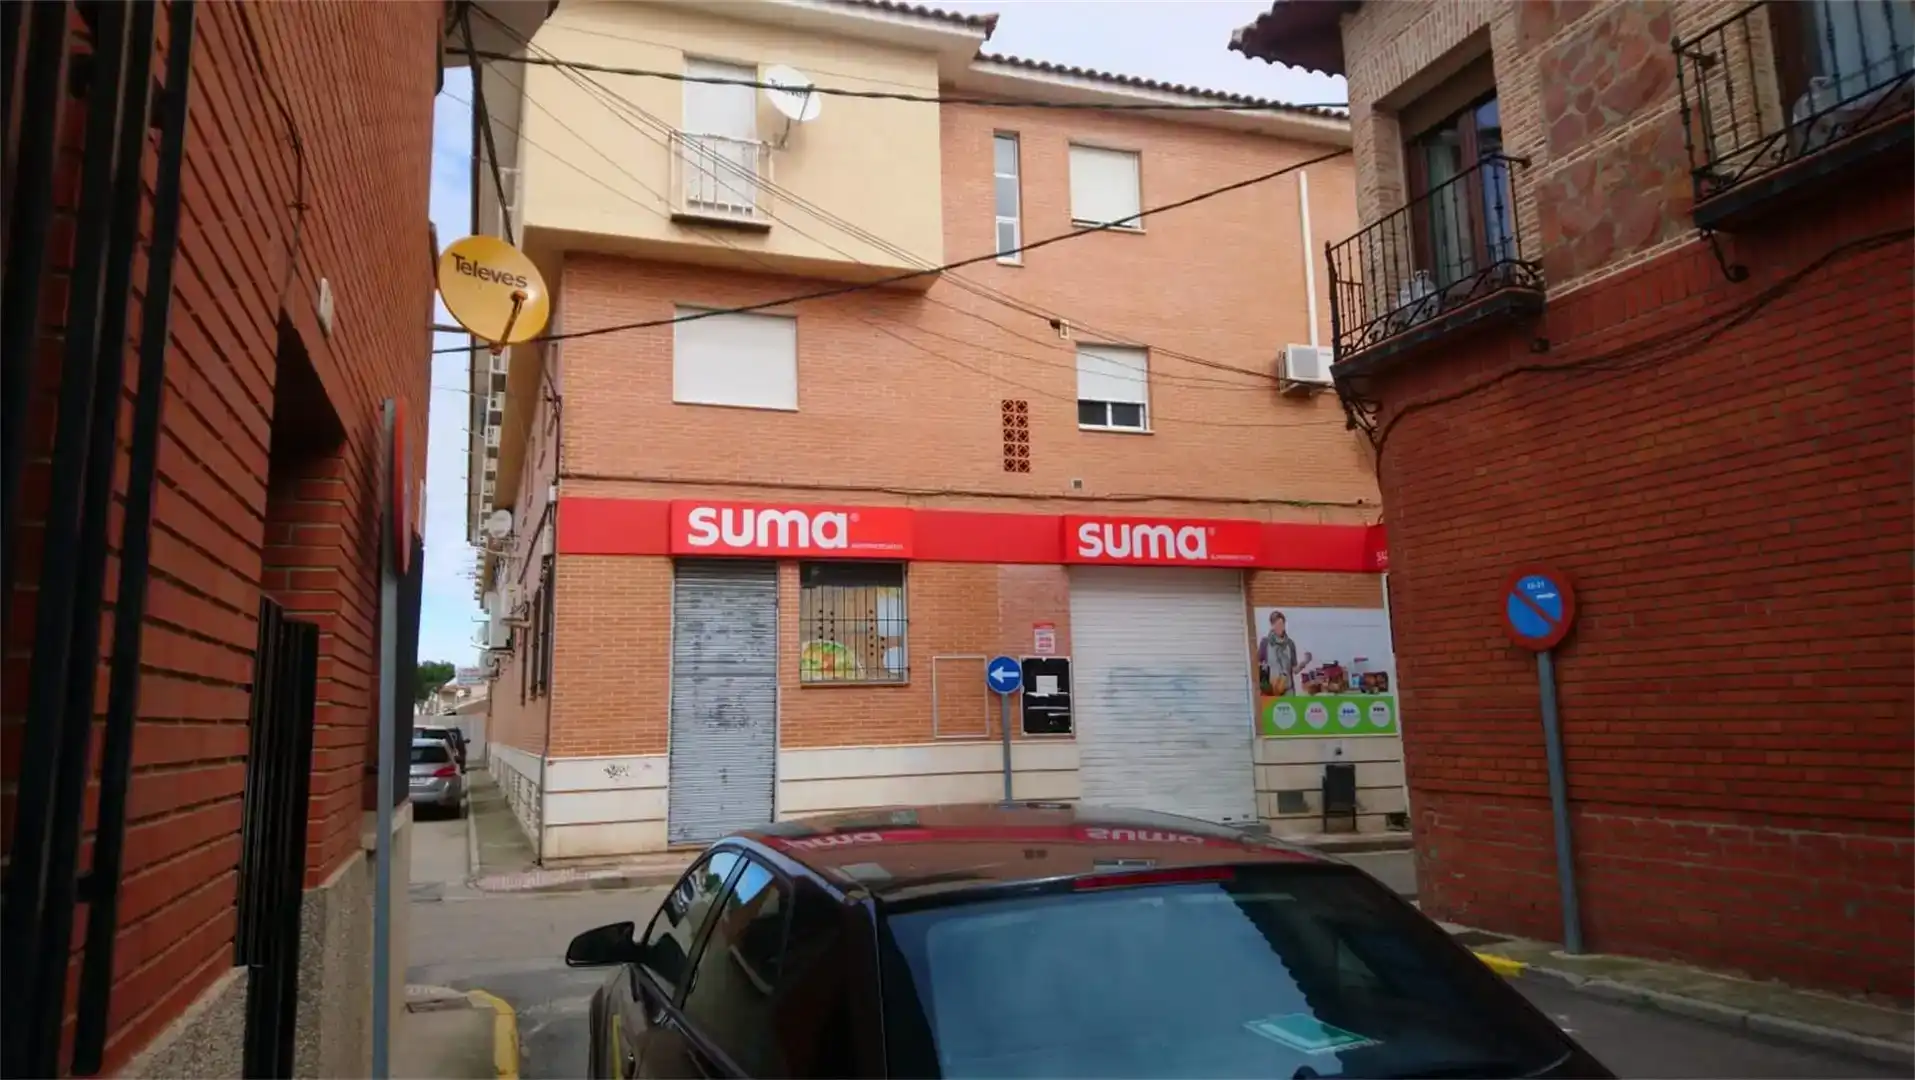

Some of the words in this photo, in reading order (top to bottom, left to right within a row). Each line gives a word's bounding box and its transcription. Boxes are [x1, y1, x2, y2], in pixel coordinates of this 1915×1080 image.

[451, 253, 528, 288] Televes
[687, 507, 848, 549] suma
[1078, 522, 1208, 560] suma
